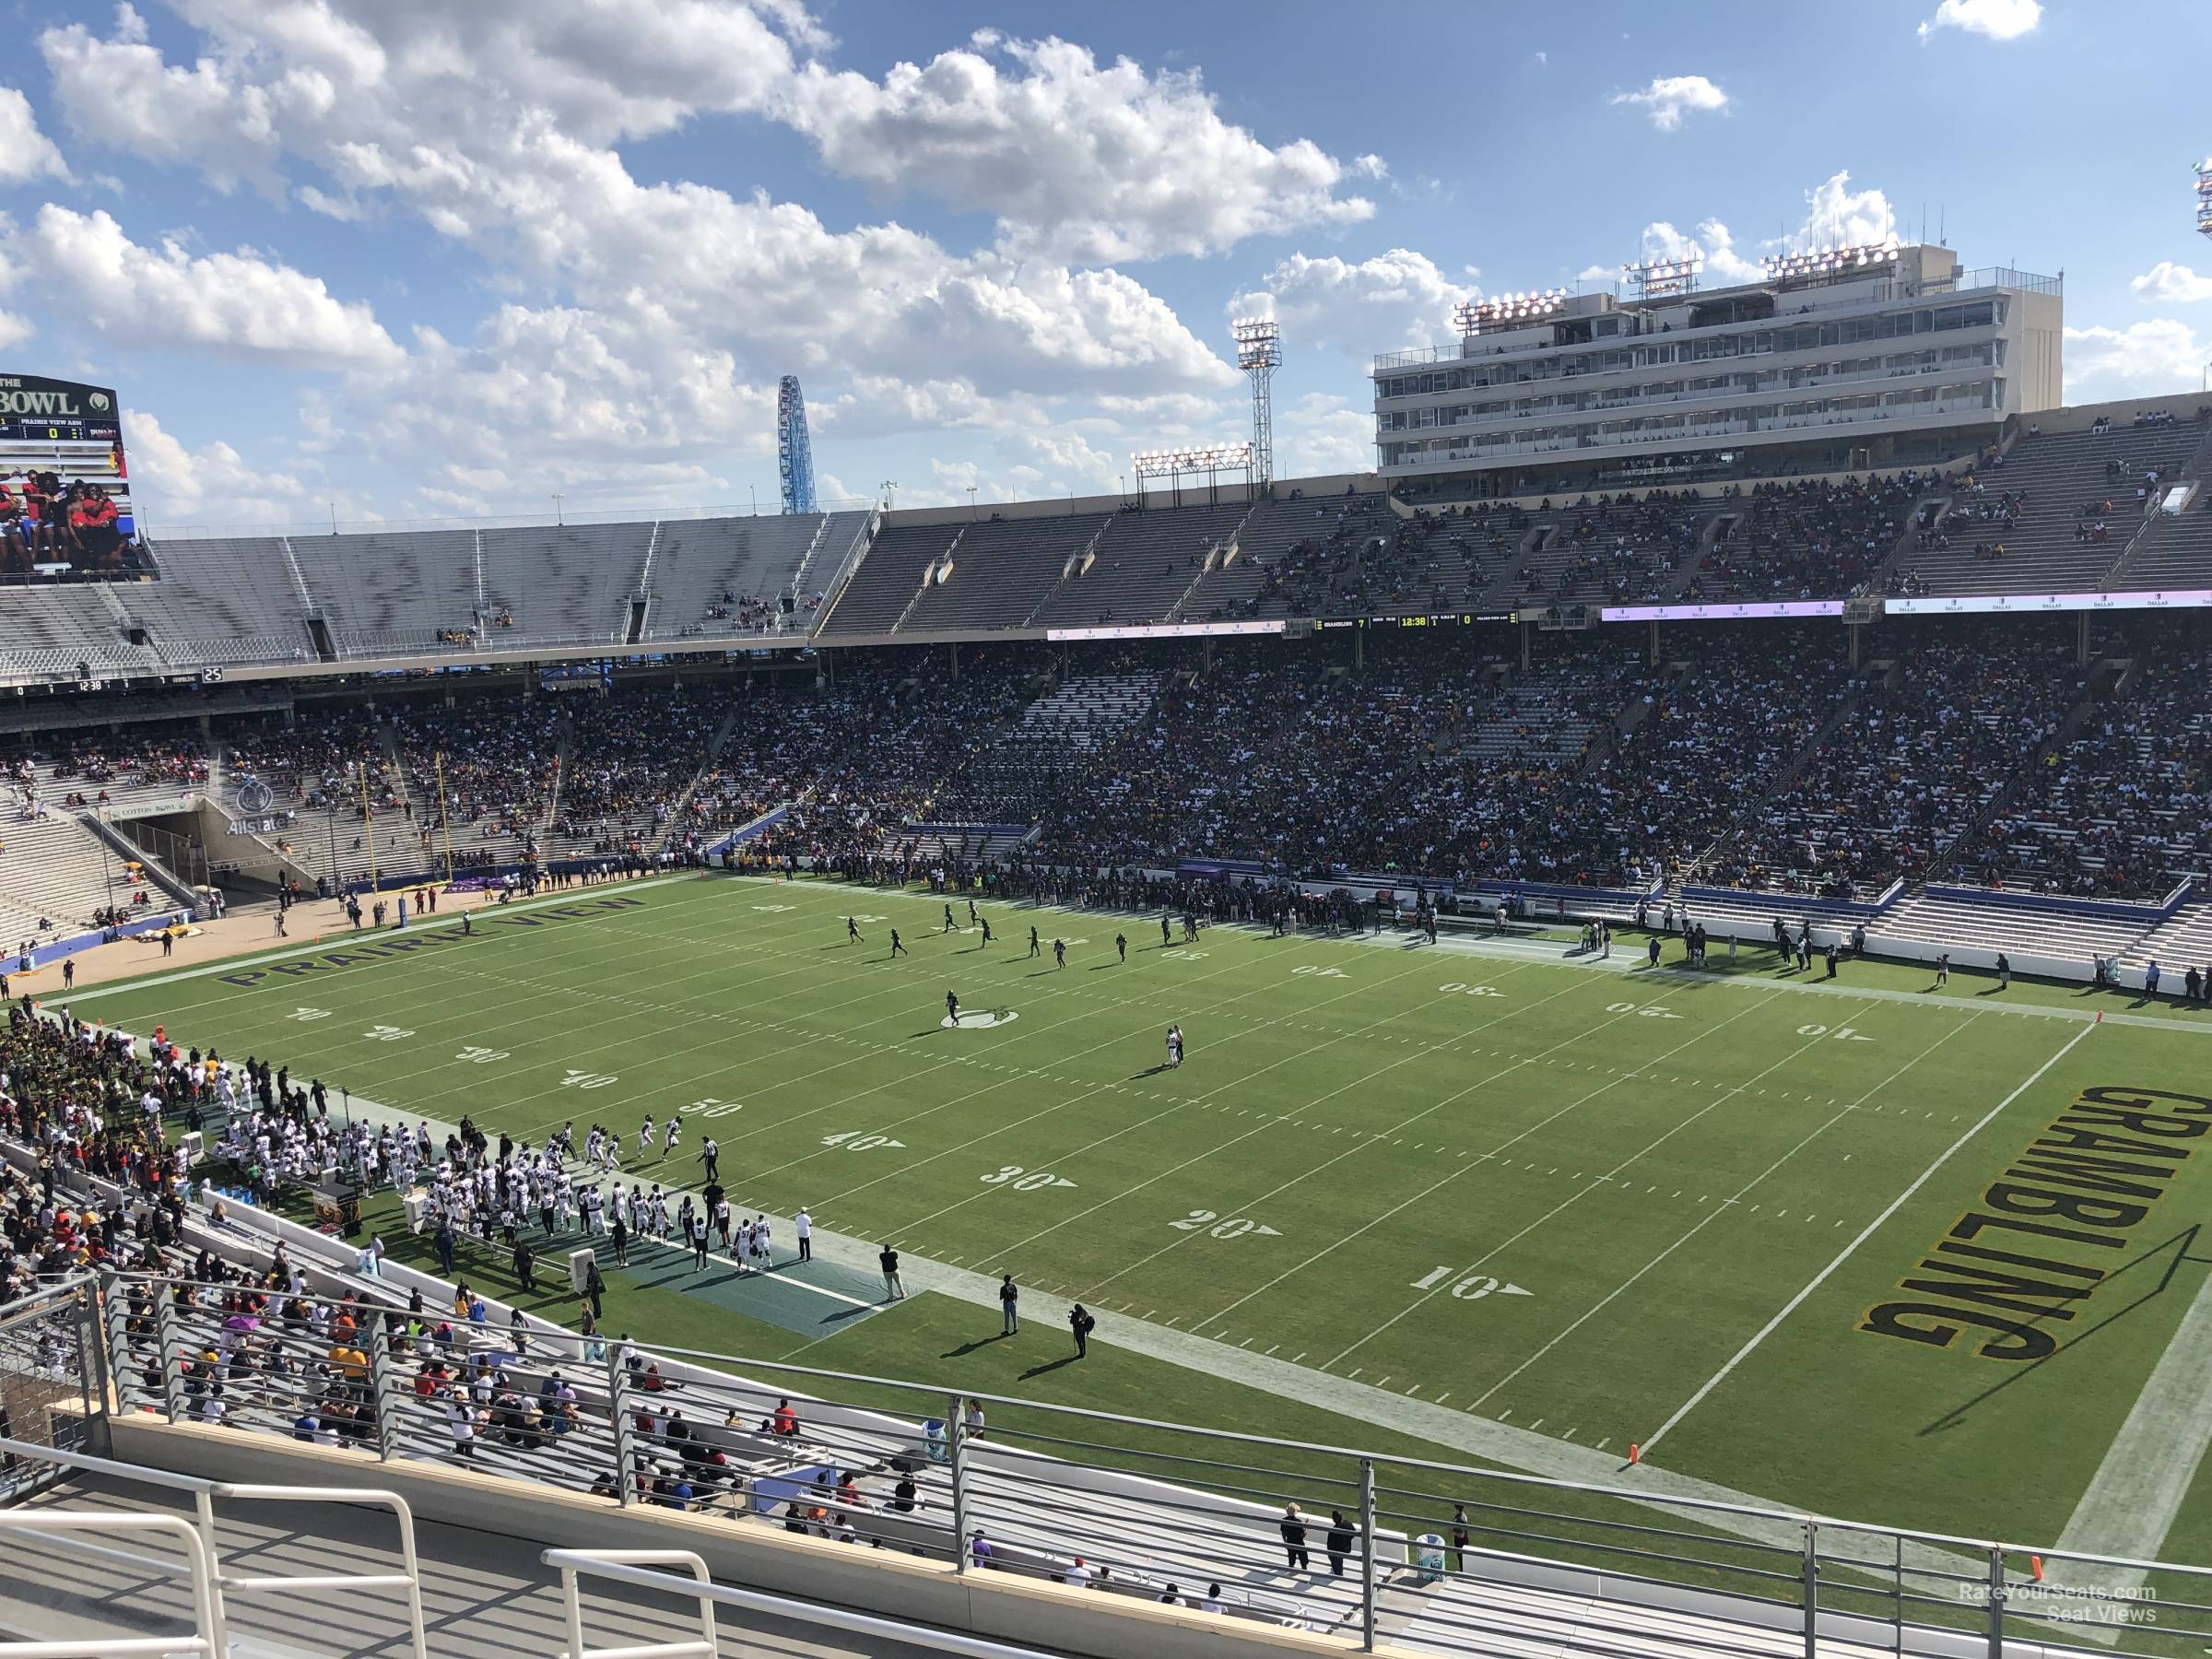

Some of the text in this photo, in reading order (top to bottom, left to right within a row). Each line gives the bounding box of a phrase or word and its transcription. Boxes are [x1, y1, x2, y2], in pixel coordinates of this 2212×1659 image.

[49, 429, 58, 439] 0
[1359, 619, 1365, 628] 7
[1402, 618, 1426, 626] 12:38
[1464, 616, 1471, 624] 0
[205, 668, 222, 681] 25
[18, 687, 24, 696] 0
[79, 681, 101, 691] 12:38
[122, 804, 177, 816] COTTON BOWL
[227, 817, 288, 836] Allstate
[217, 896, 648, 989] PRAIRIE VIEW
[1161, 950, 1210, 961] 50
[1291, 965, 1343, 976] 40
[1438, 982, 1498, 996] 30
[285, 1008, 333, 1021] 10
[1606, 1002, 1672, 1017] 20
[362, 1027, 416, 1041] 20
[1796, 1024, 1858, 1040] 10
[454, 1048, 512, 1064] 30
[559, 1073, 619, 1089] 40
[678, 1098, 743, 1118] 50
[820, 1130, 888, 1151] 40
[979, 1165, 1056, 1191] 30
[1167, 1209, 1255, 1240] 20
[1853, 1085, 2212, 1361] GRAMBLING
[1409, 1265, 1499, 1300] 10
